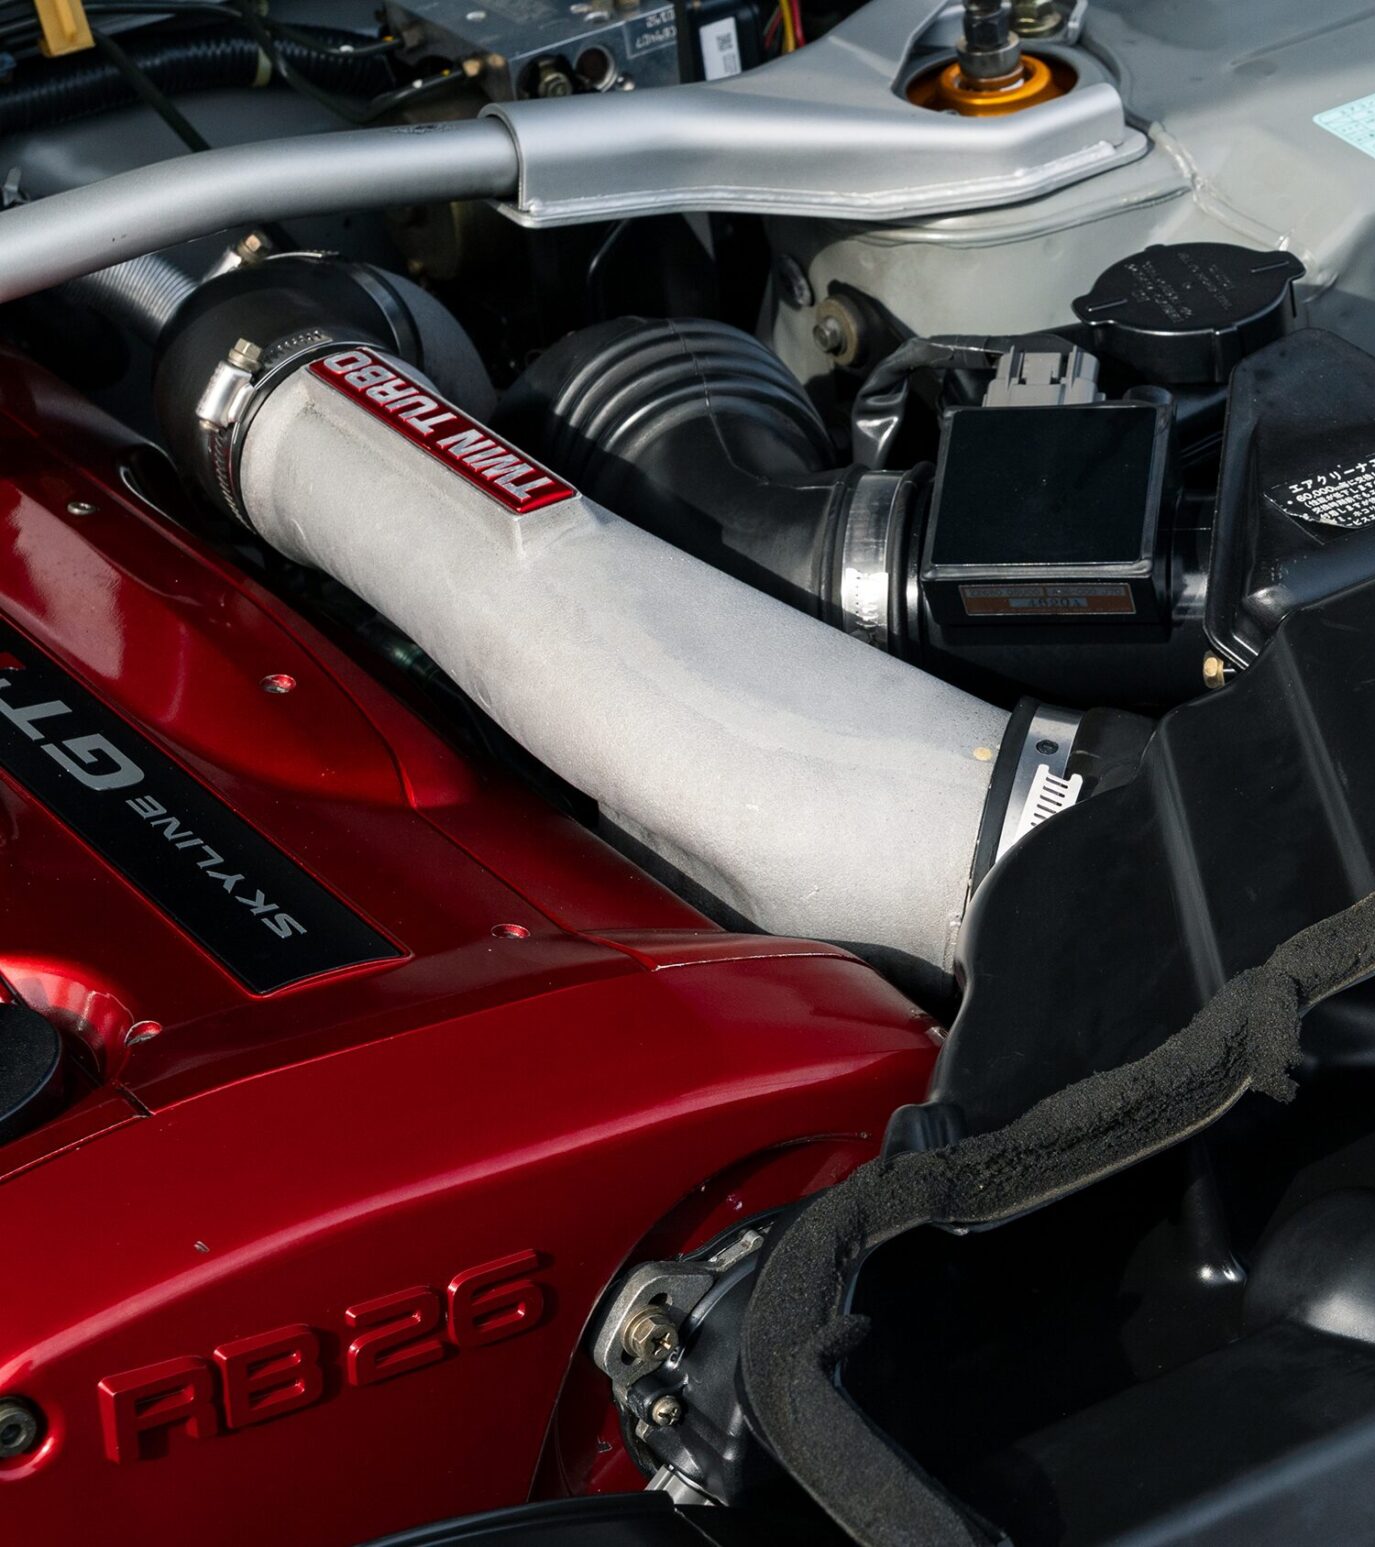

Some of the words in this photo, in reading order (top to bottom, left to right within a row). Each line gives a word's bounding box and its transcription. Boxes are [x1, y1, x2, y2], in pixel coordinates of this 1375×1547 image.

[323, 350, 457, 435] TURBO
[436, 428, 554, 502] TWIN
[0, 676, 145, 791] GT
[126, 795, 308, 939] SKYLINE
[98, 1248, 544, 1465] RB26
